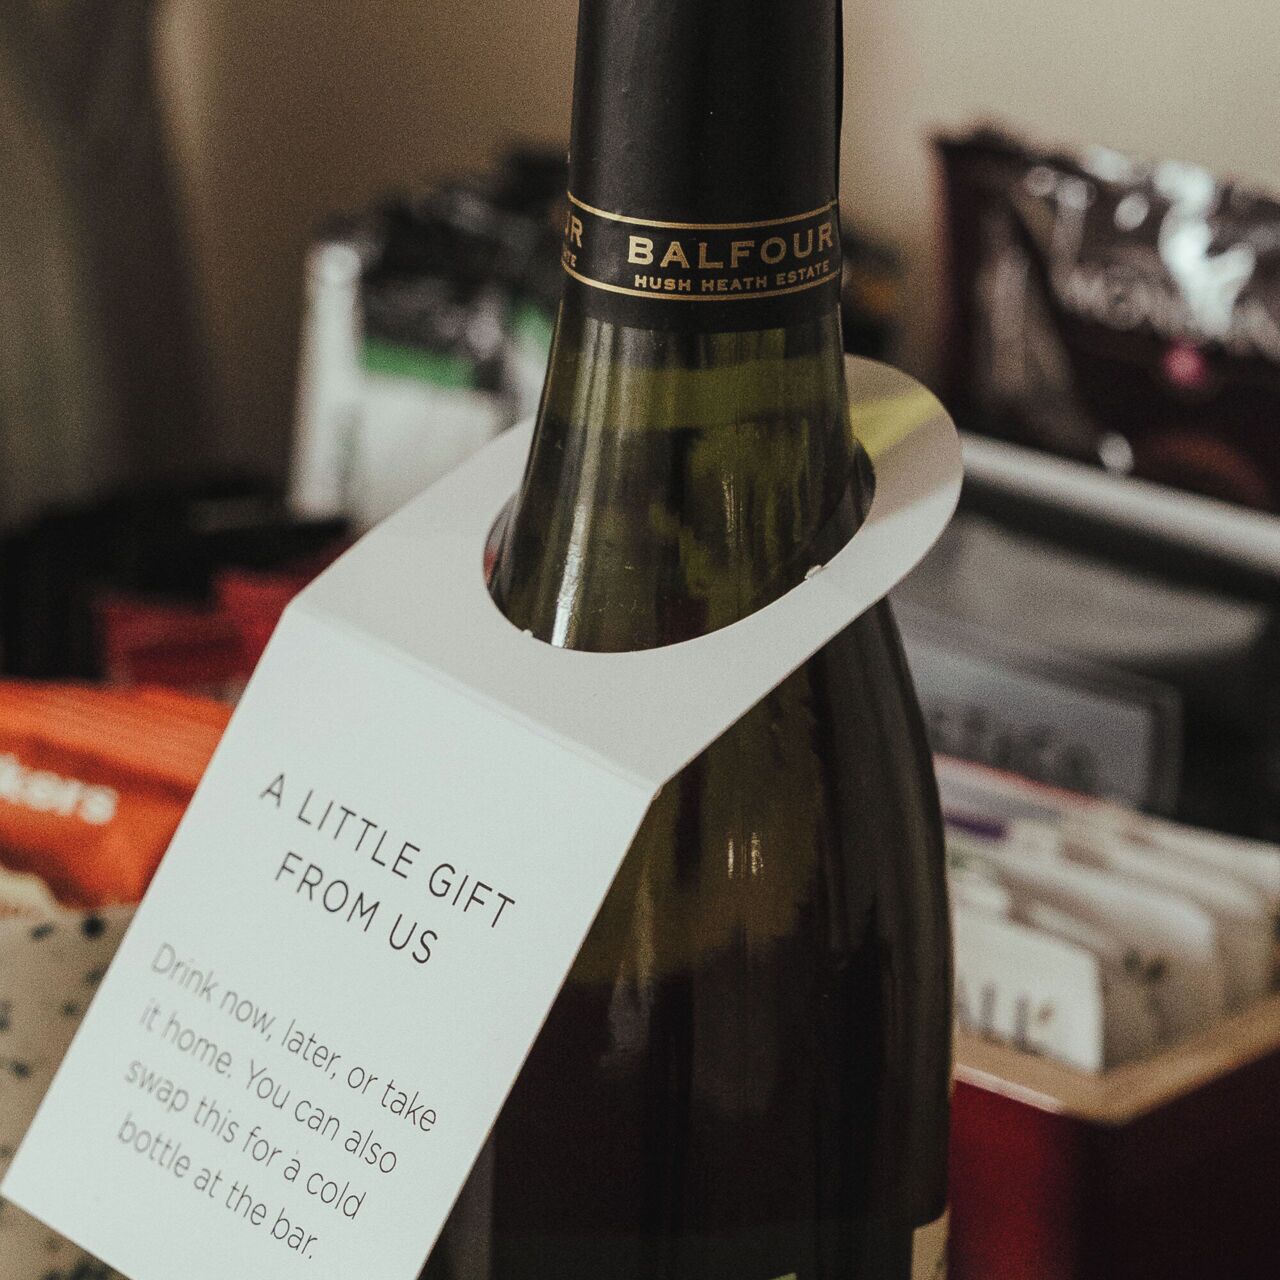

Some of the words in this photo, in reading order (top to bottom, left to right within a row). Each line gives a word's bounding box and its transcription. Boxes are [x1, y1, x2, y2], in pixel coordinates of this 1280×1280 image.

[627, 222, 834, 270] BALFOUR
[634, 274, 691, 292] HUSH
[701, 275, 767, 293] HEATH
[776, 260, 830, 286] ESTATE
[258, 773, 284, 808] A
[297, 789, 421, 879] LITTLE
[429, 863, 516, 928] GIFT
[275, 851, 380, 933] FROM
[389, 913, 438, 964] US
[139, 998, 161, 1032] it
[161, 1012, 232, 1078] home.
[246, 1059, 291, 1110] You
[294, 1100, 340, 1141] can
[344, 1129, 397, 1174] also
[151, 942, 218, 1003] Drink
[220, 989, 276, 1043] now,
[281, 1019, 341, 1080] later,
[347, 1066, 378, 1095] or
[381, 1079, 437, 1132] take
[117, 1114, 191, 1178] bottle
[193, 1168, 224, 1199] at
[225, 1181, 268, 1226] the
[270, 1207, 319, 1260] bar.
[124, 1060, 189, 1113] swap
[193, 1095, 239, 1144] this
[242, 1125, 283, 1167] for
[283, 1158, 302, 1183] a
[306, 1172, 367, 1220] cold
